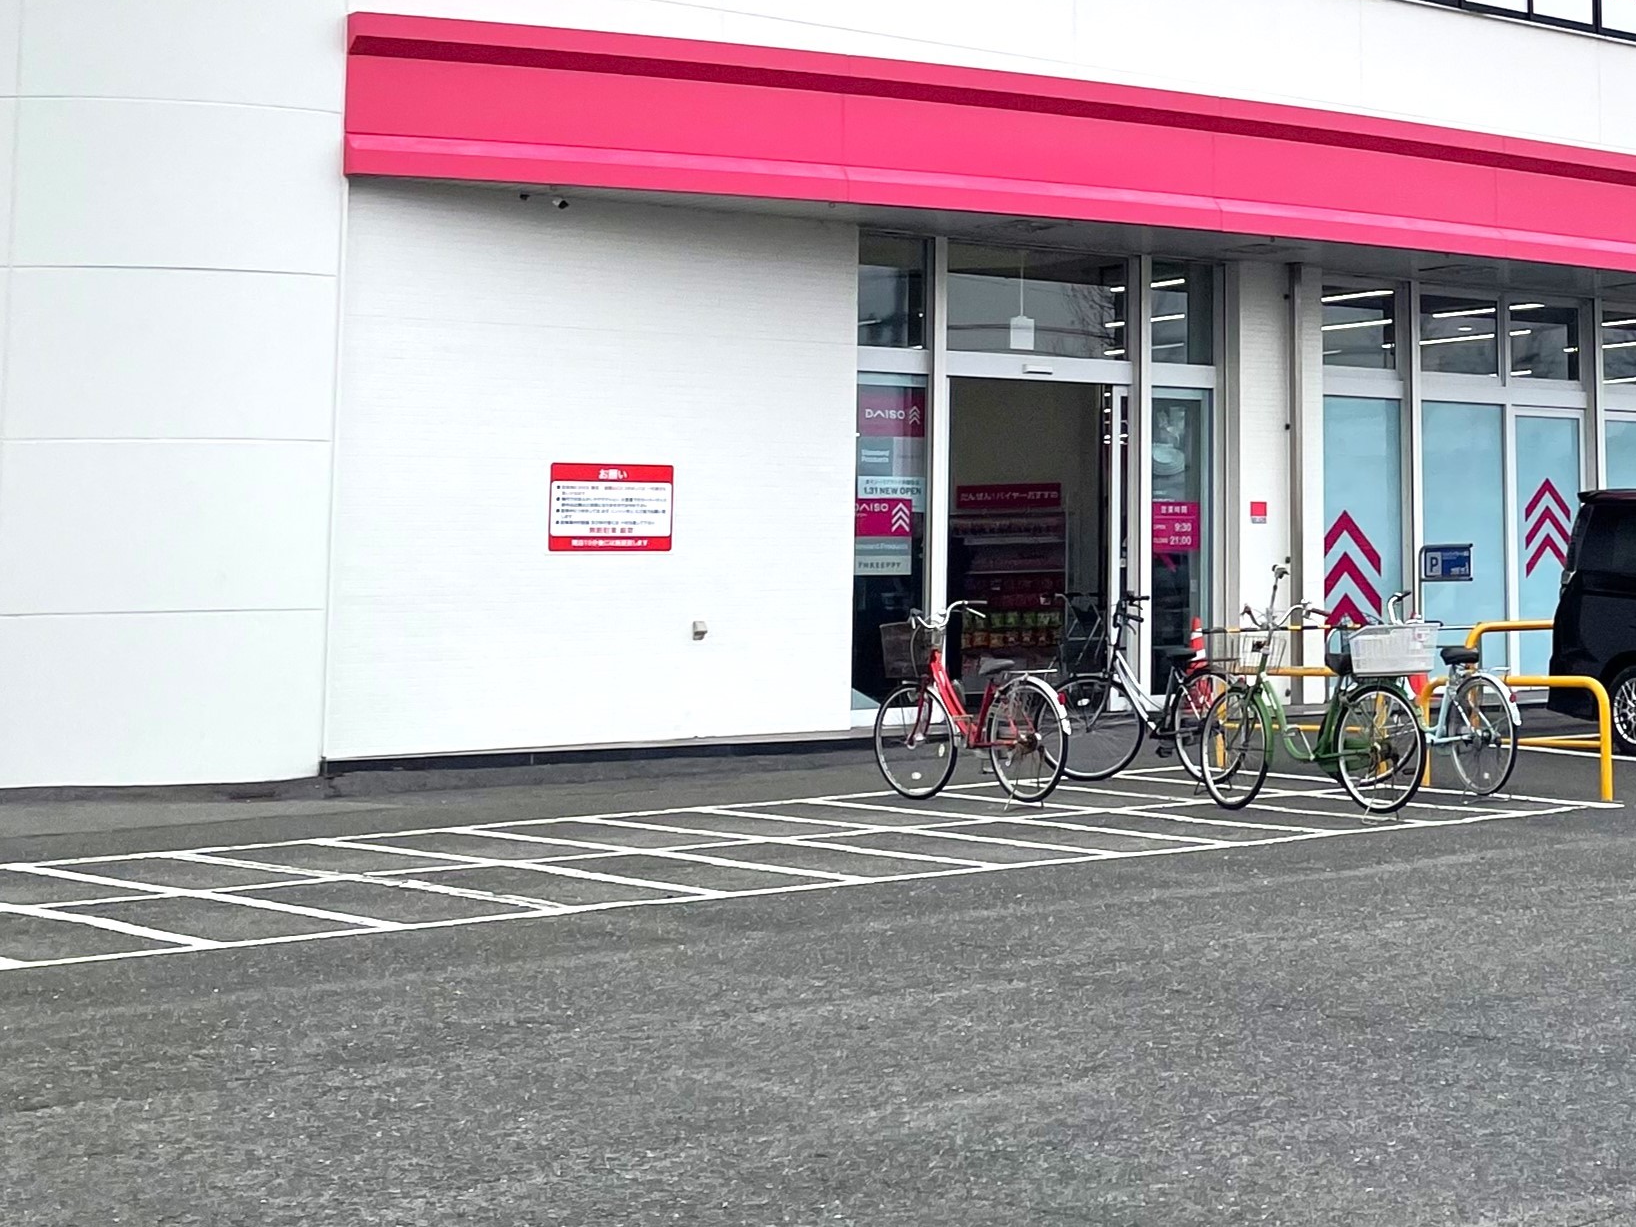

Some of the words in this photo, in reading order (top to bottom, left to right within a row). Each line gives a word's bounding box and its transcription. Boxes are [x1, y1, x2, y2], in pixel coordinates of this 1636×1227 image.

[864, 408, 905, 420] DAISO
[879, 486, 898, 495] NEW
[899, 486, 922, 496] OPEN
[1174, 522, 1192, 532] 9:30
[1169, 535, 1192, 545] 21:00
[1430, 556, 1439, 573] P
